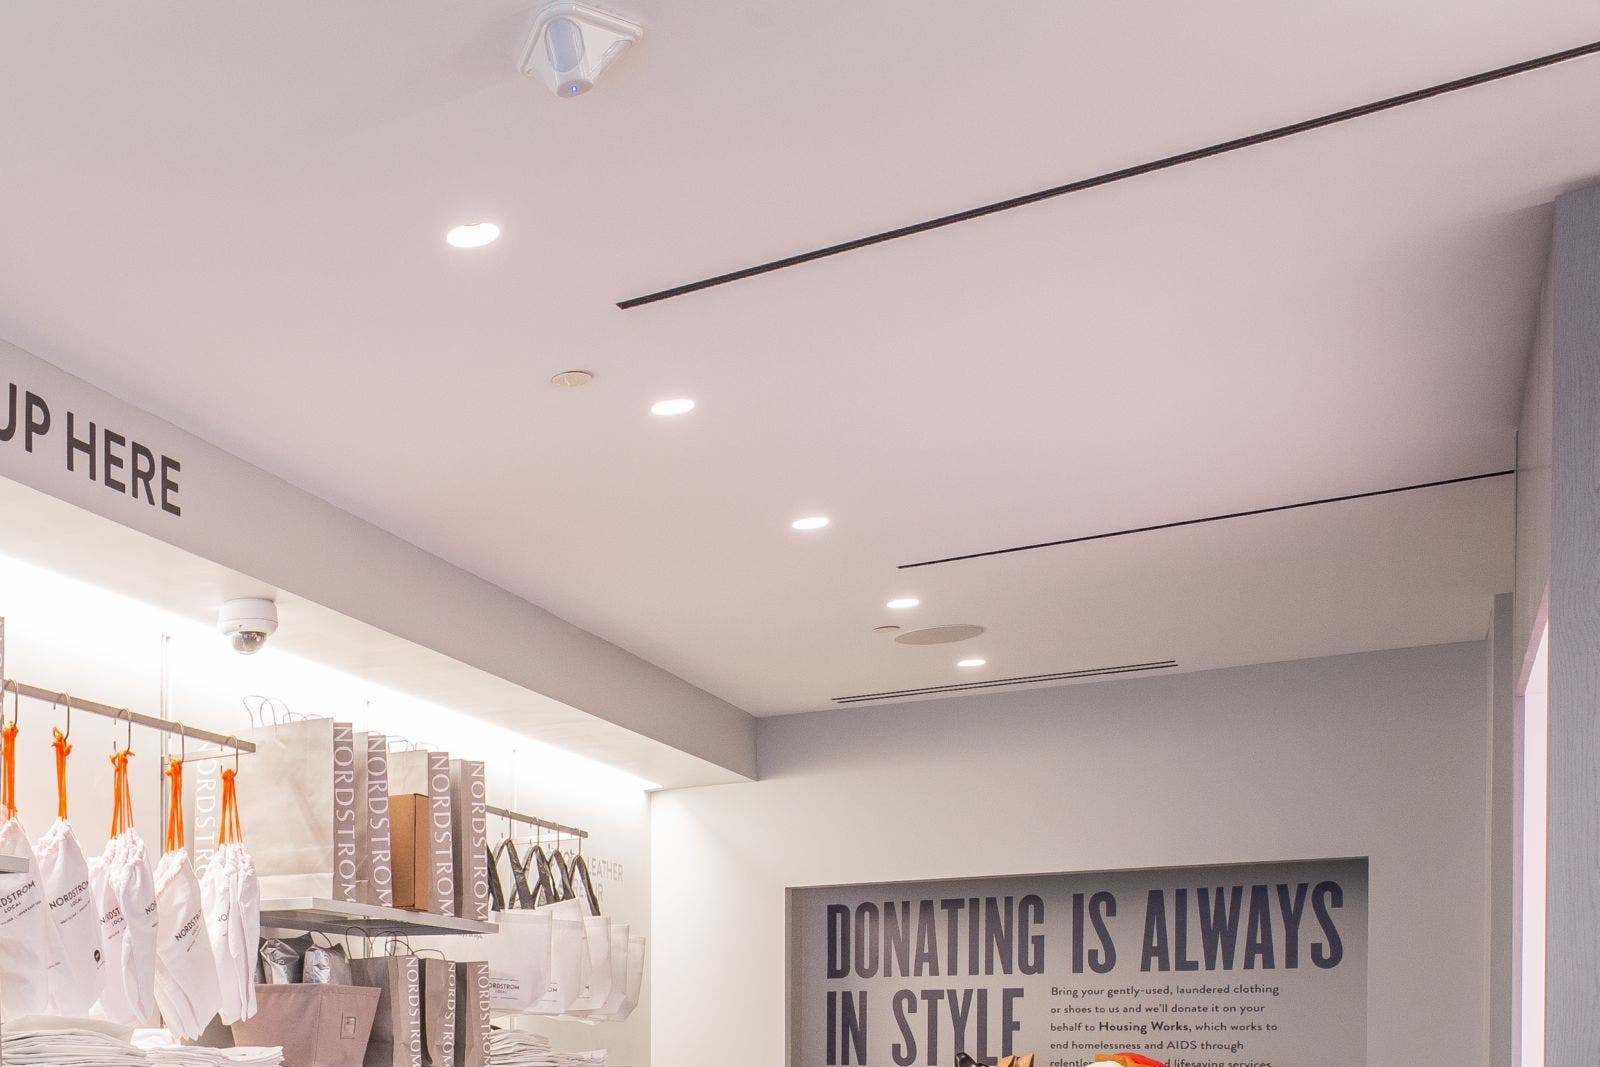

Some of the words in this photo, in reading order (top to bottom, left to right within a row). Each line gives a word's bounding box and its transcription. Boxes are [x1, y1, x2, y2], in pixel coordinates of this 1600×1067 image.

[65, 410, 183, 518] HERE
[333, 725, 357, 903] NORDSTROM
[367, 735, 393, 908] NORDSTROM
[430, 755, 456, 918] NORDSTROM
[470, 762, 489, 922] NORDSTROM
[826, 893, 1046, 979] DONATING
[1071, 891, 1117, 975] IS
[1140, 880, 1344, 973] ALWAYS
[442, 962, 456, 1067] NORDSTROM
[477, 964, 492, 1067] NORDSTROM
[826, 990, 868, 1067] IN
[891, 987, 1025, 1067] STYLE
[1050, 1006, 1061, 1014] or
[1064, 1004, 1092, 1014] shoes
[1095, 1005, 1105, 1014] to
[1108, 1006, 1120, 1014] us
[1123, 1003, 1142, 1014] and
[1145, 1003, 1168, 1014] we'll
[1171, 1003, 1209, 1014] donate
[1211, 1003, 1220, 1013] it
[1222, 1005, 1237, 1013] on
[1239, 1004, 1266, 1016] your
[1050, 1022, 1082, 1033] behalf
[1085, 1023, 1096, 1032] to
[1099, 1021, 1148, 1035] Housing
[1151, 1021, 1192, 1034] Works,
[1195, 1021, 1227, 1032] which
[1230, 1022, 1263, 1032] works
[1266, 1023, 1278, 1032] to
[1051, 986, 1079, 998] Bring
[1081, 987, 1104, 998] your
[1107, 985, 1174, 998] gently-used,
[1176, 985, 1231, 996] laundered
[1233, 984, 1280, 997] clothing
[1050, 1040, 1069, 1050] end
[1071, 1040, 1142, 1050] homelessness
[1144, 1040, 1164, 1050] and
[1167, 1040, 1197, 1050] AIDS
[1200, 1040, 1244, 1053] through
